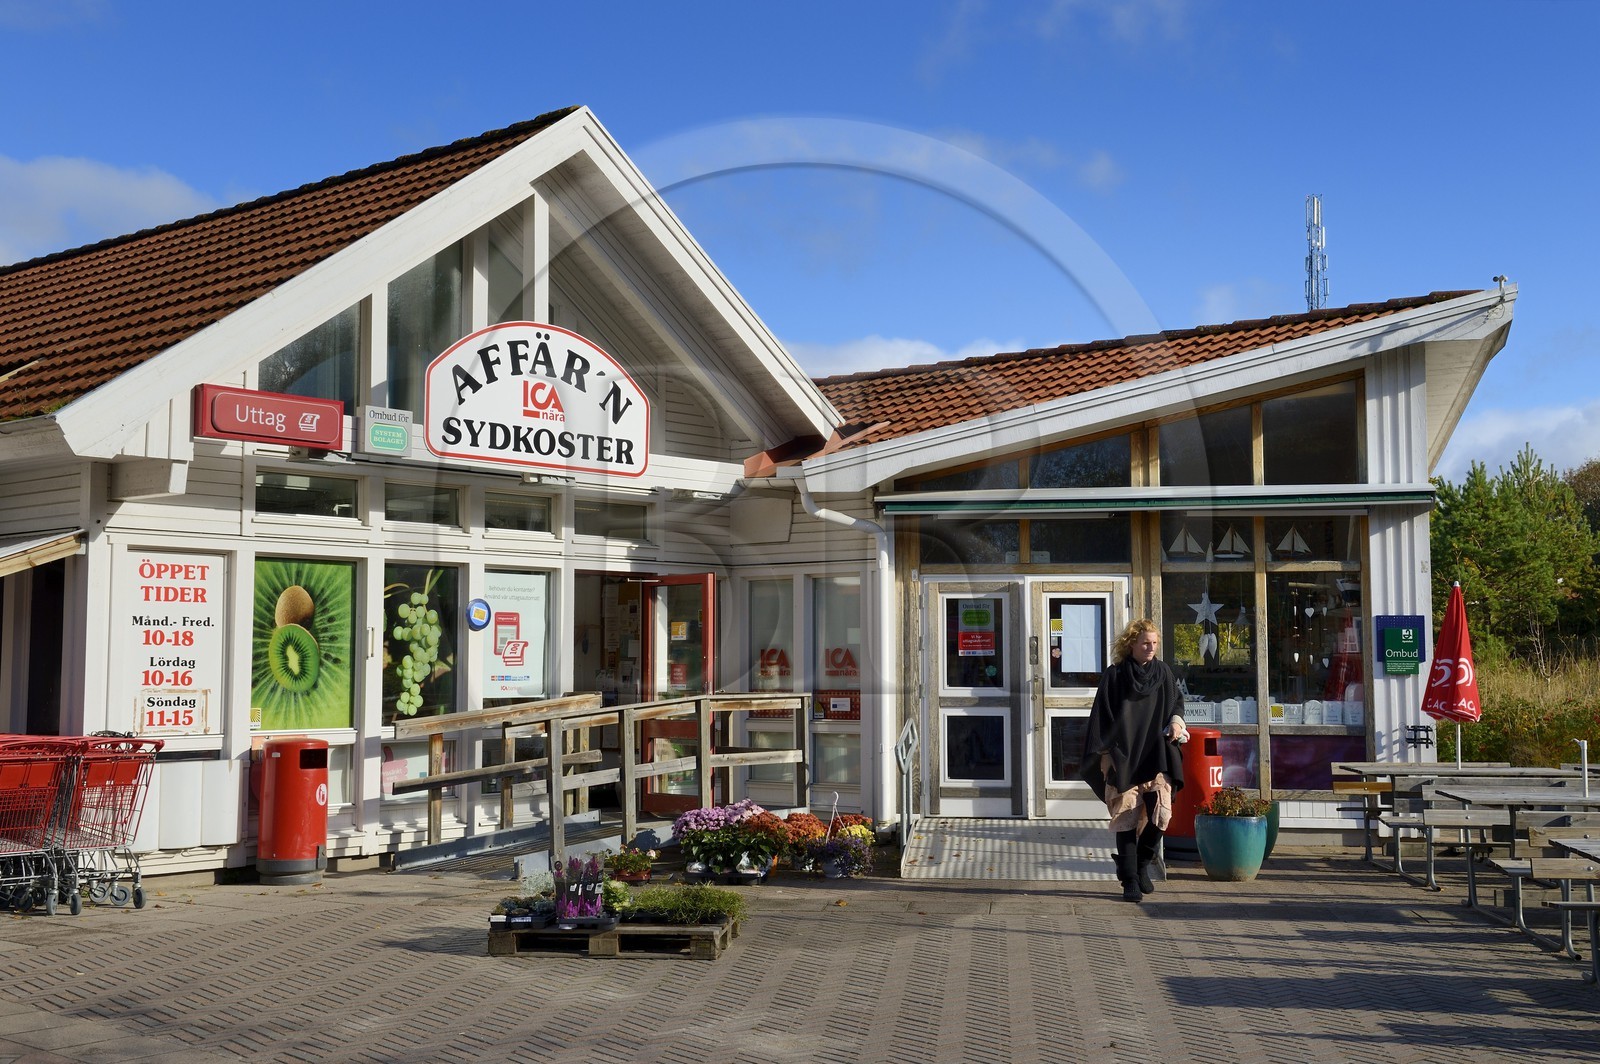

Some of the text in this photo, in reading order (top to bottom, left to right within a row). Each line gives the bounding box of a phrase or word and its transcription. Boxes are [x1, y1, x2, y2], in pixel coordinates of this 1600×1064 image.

[523, 380, 564, 412] ICA
[235, 404, 287, 433] Uttag
[369, 410, 409, 422] Ombud för
[541, 409, 565, 422] nära
[373, 436, 404, 444] BOLAGET
[375, 430, 402, 438] SYSTEM
[442, 416, 634, 465] SYDKOSTER
[138, 558, 209, 581] ÖPPET
[140, 585, 207, 603] TIDER
[182, 616, 215, 627] Fred.
[142, 629, 194, 647] 10-18
[760, 648, 790, 668] ICA
[825, 648, 857, 669] ICA
[1385, 649, 1418, 658] Ombud
[149, 656, 196, 669] Lördag
[141, 670, 193, 687] 10-16
[146, 697, 196, 708] Söndag
[146, 710, 194, 727] 11-15
